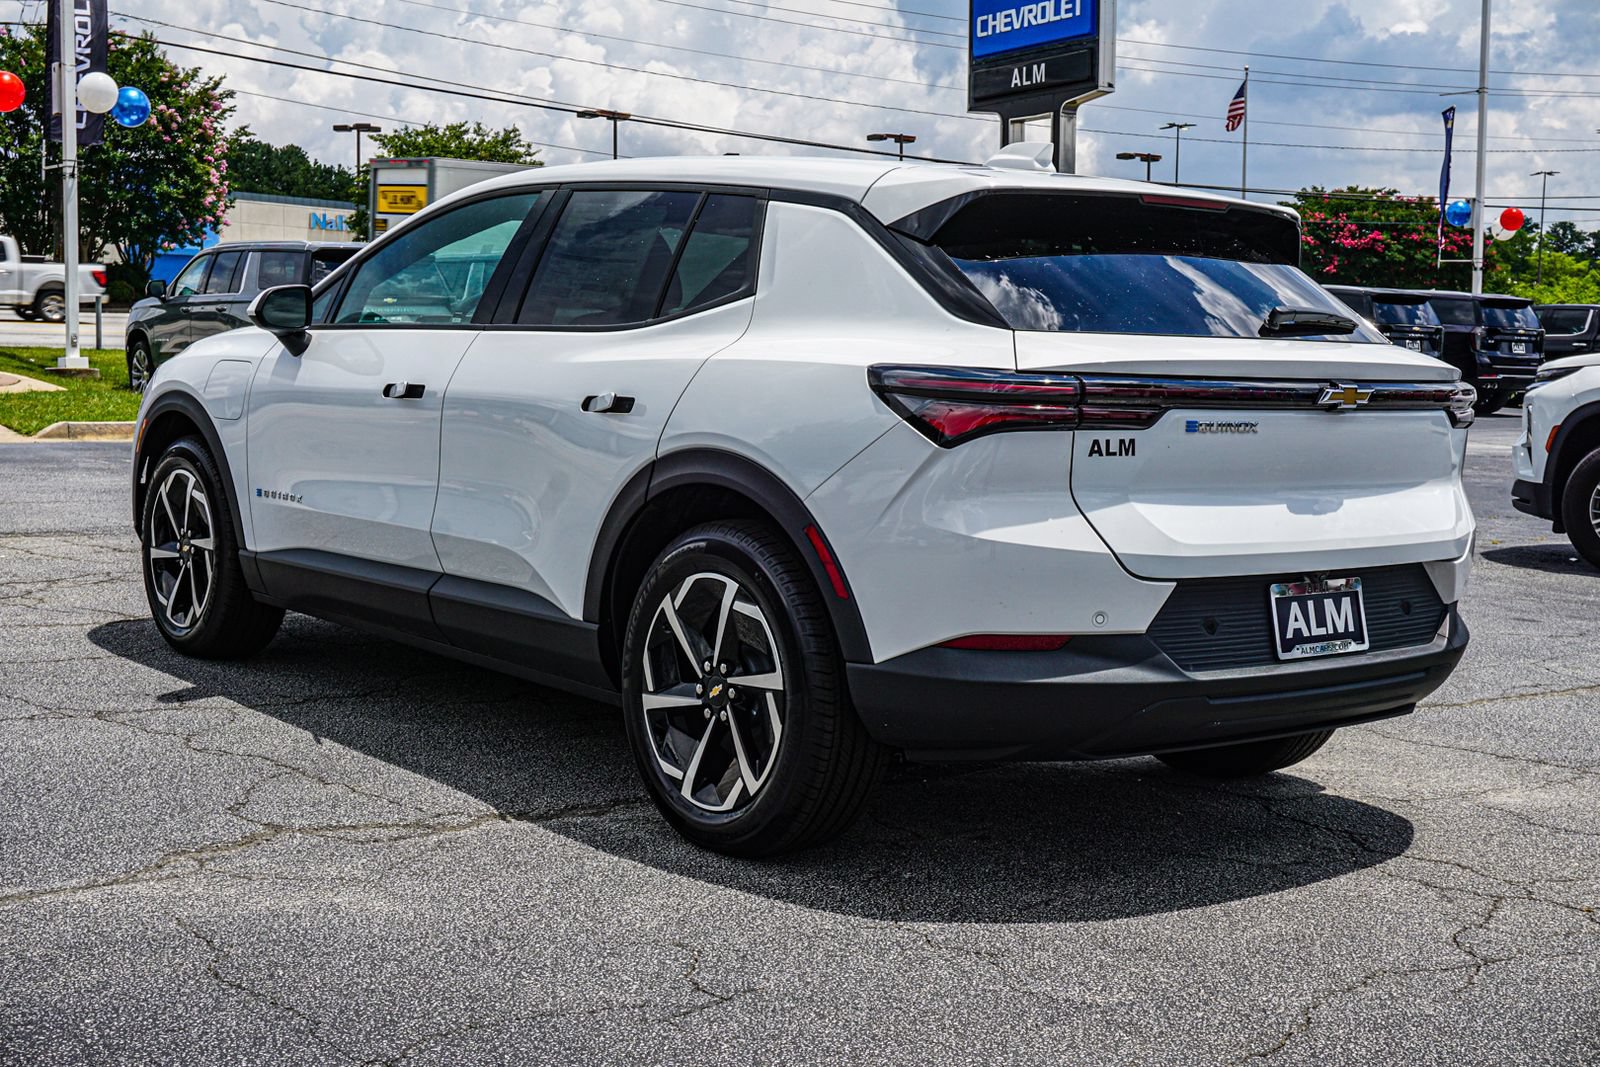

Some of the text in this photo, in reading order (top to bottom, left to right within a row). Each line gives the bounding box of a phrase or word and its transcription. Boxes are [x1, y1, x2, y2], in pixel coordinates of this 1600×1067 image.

[976, 0, 1081, 37] CHEVROLET
[1011, 62, 1046, 88] ALM
[1185, 420, 1259, 433] EQUINOX
[1088, 438, 1136, 457] ALM
[1286, 596, 1355, 639] ALM
